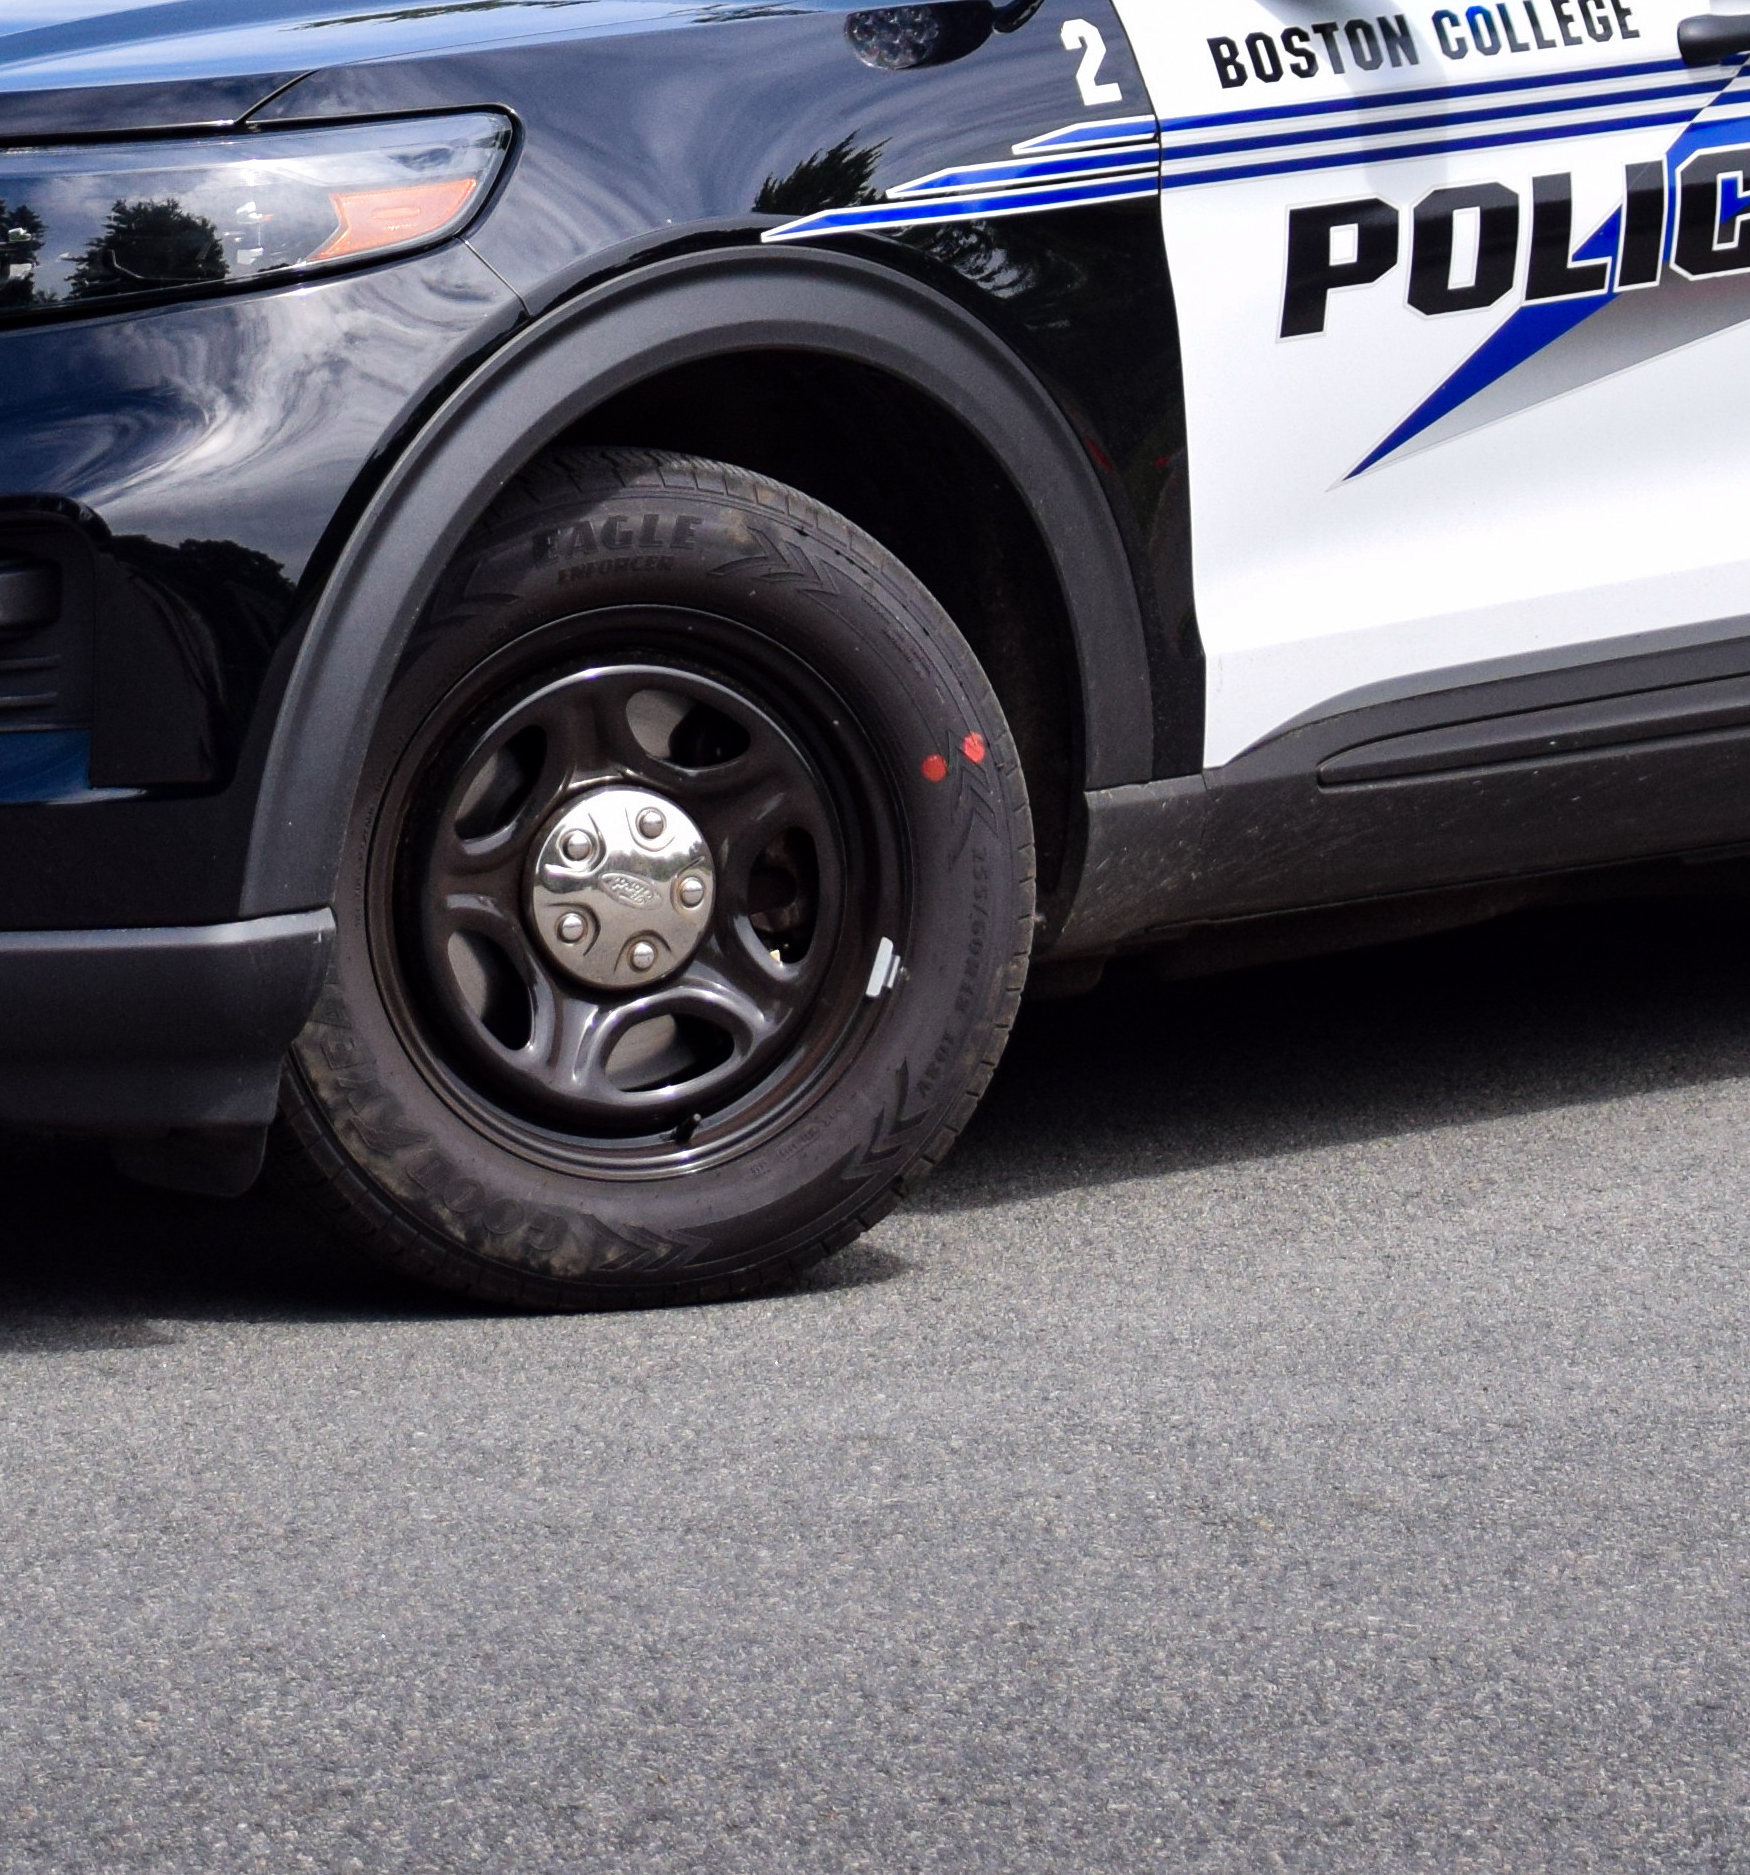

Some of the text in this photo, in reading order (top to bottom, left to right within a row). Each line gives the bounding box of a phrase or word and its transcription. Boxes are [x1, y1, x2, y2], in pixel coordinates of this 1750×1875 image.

[1059, 18, 1123, 106] 2
[1207, 14, 1420, 89] BOSTON
[531, 513, 702, 567] EAGLE
